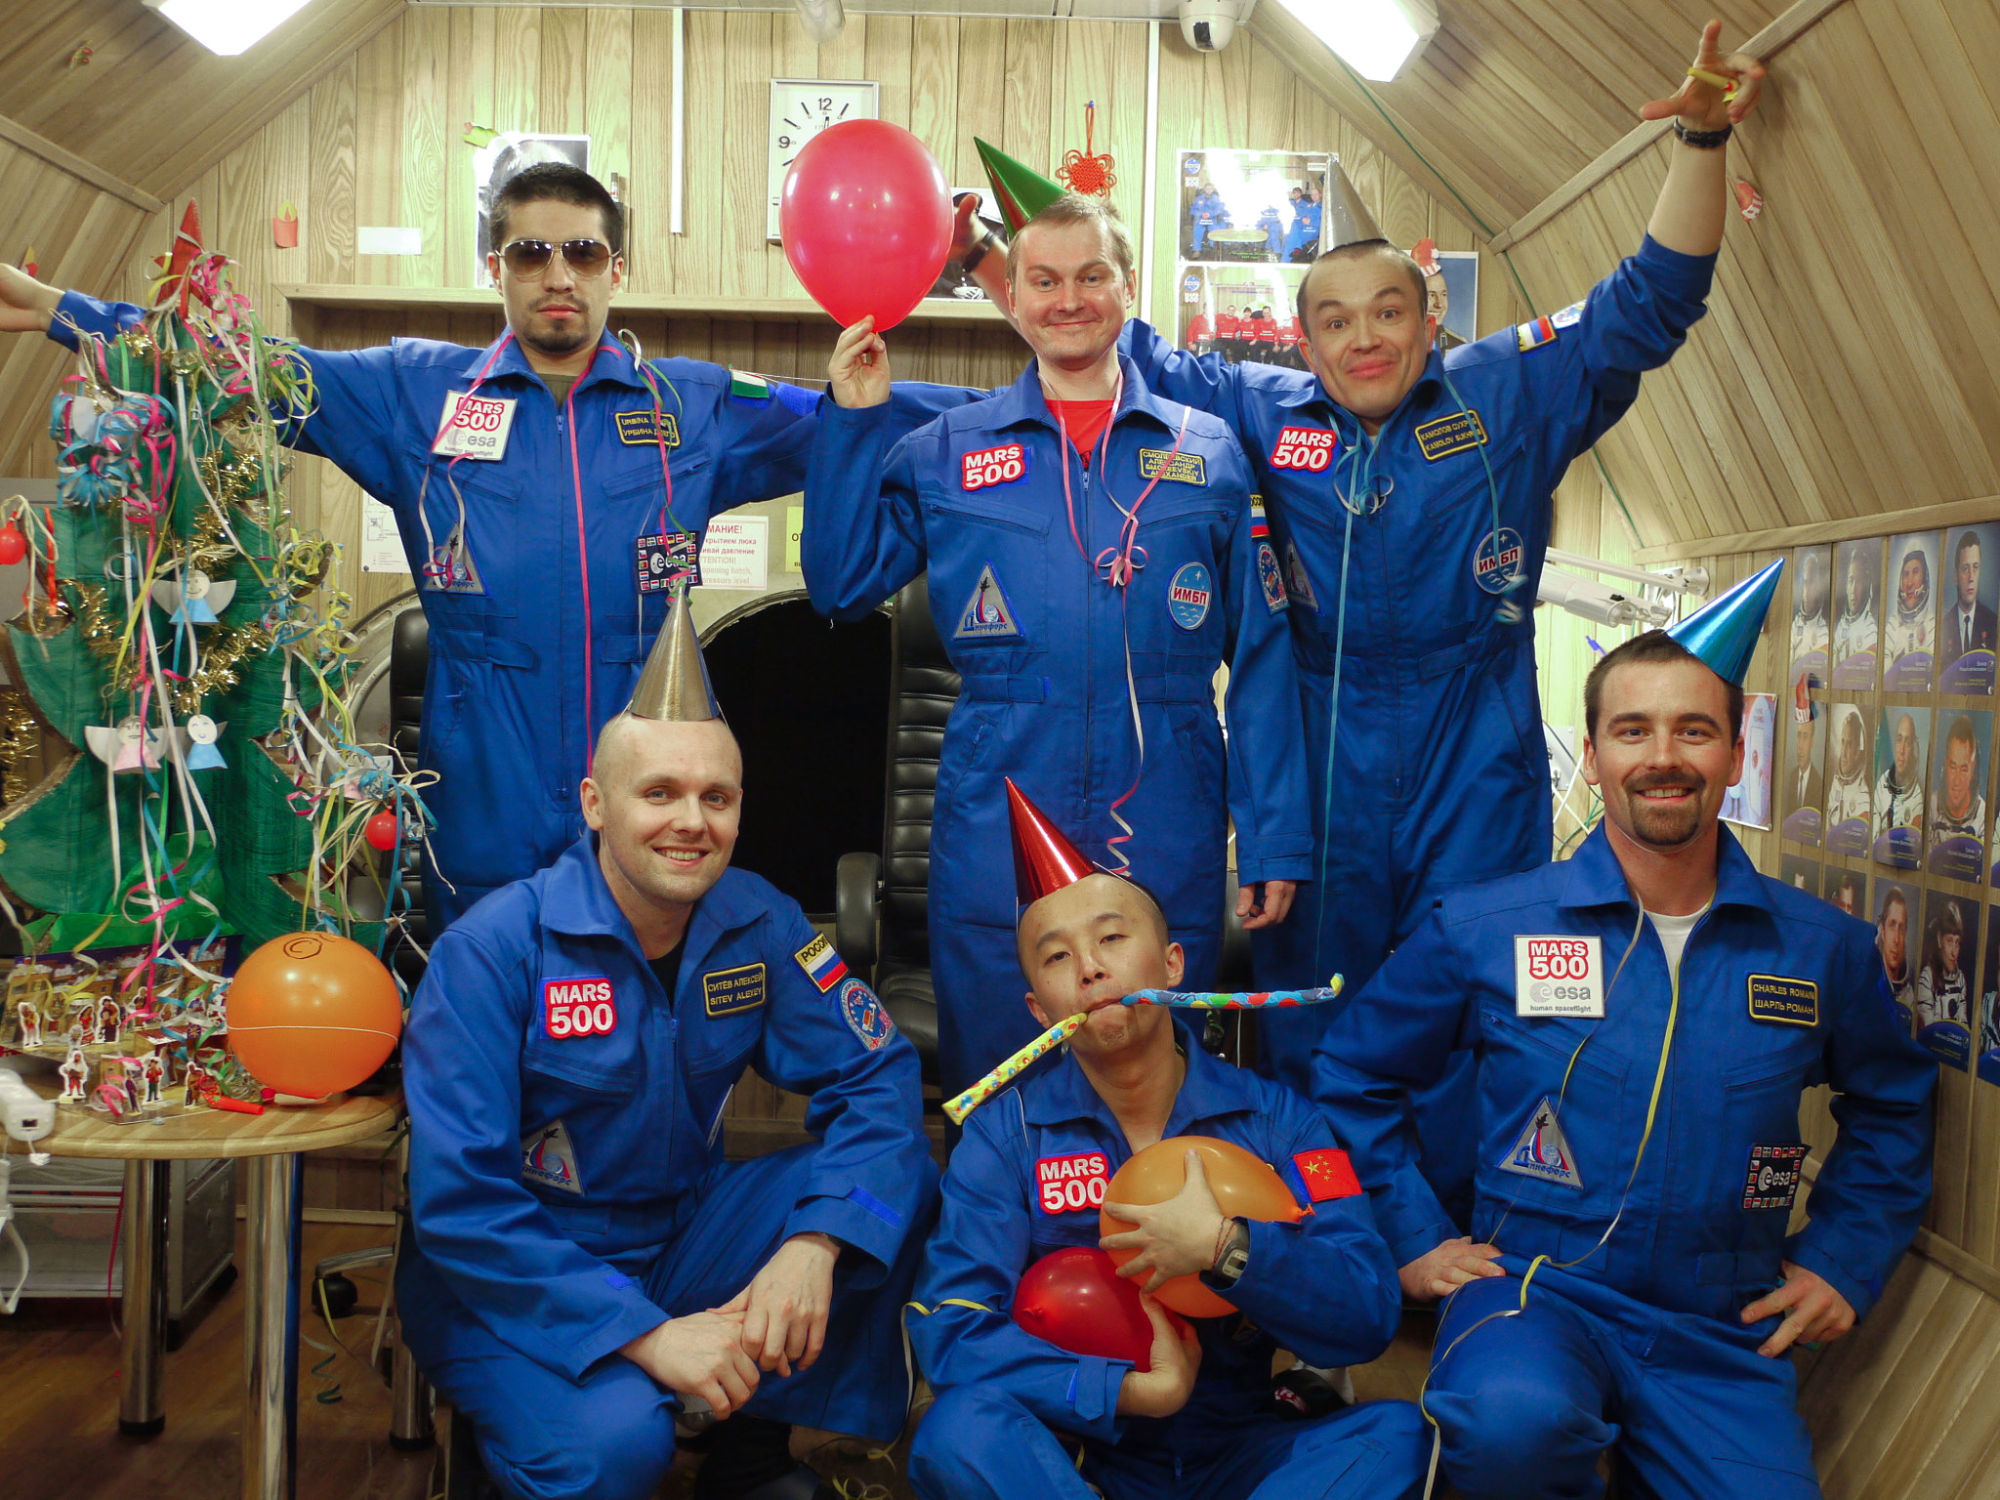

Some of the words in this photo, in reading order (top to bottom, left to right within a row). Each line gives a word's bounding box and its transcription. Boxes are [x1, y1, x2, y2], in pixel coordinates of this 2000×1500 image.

[818, 97, 832, 111] 12
[778, 136, 791, 149] 9
[458, 398, 504, 415] MARS
[456, 409, 500, 431] 500
[467, 435, 497, 447] esa
[1280, 430, 1333, 447] MARS
[965, 446, 1021, 469] MARS
[1273, 445, 1328, 469] 500
[965, 460, 1022, 488] 500
[1479, 548, 1519, 573] ИМБП
[1173, 587, 1208, 605] ИМБП
[1529, 942, 1587, 956] MARS
[1531, 956, 1587, 977] 500
[550, 982, 612, 1005] MARS
[1553, 986, 1592, 1000] esa
[1753, 983, 1788, 996] CHARLES
[710, 994, 733, 1006] SITEV
[1554, 1005, 1592, 1014] spaceflight
[551, 1003, 614, 1035] 500
[1040, 1156, 1105, 1181] MARS
[1772, 1171, 1791, 1186] esa
[1043, 1176, 1108, 1210] 500
